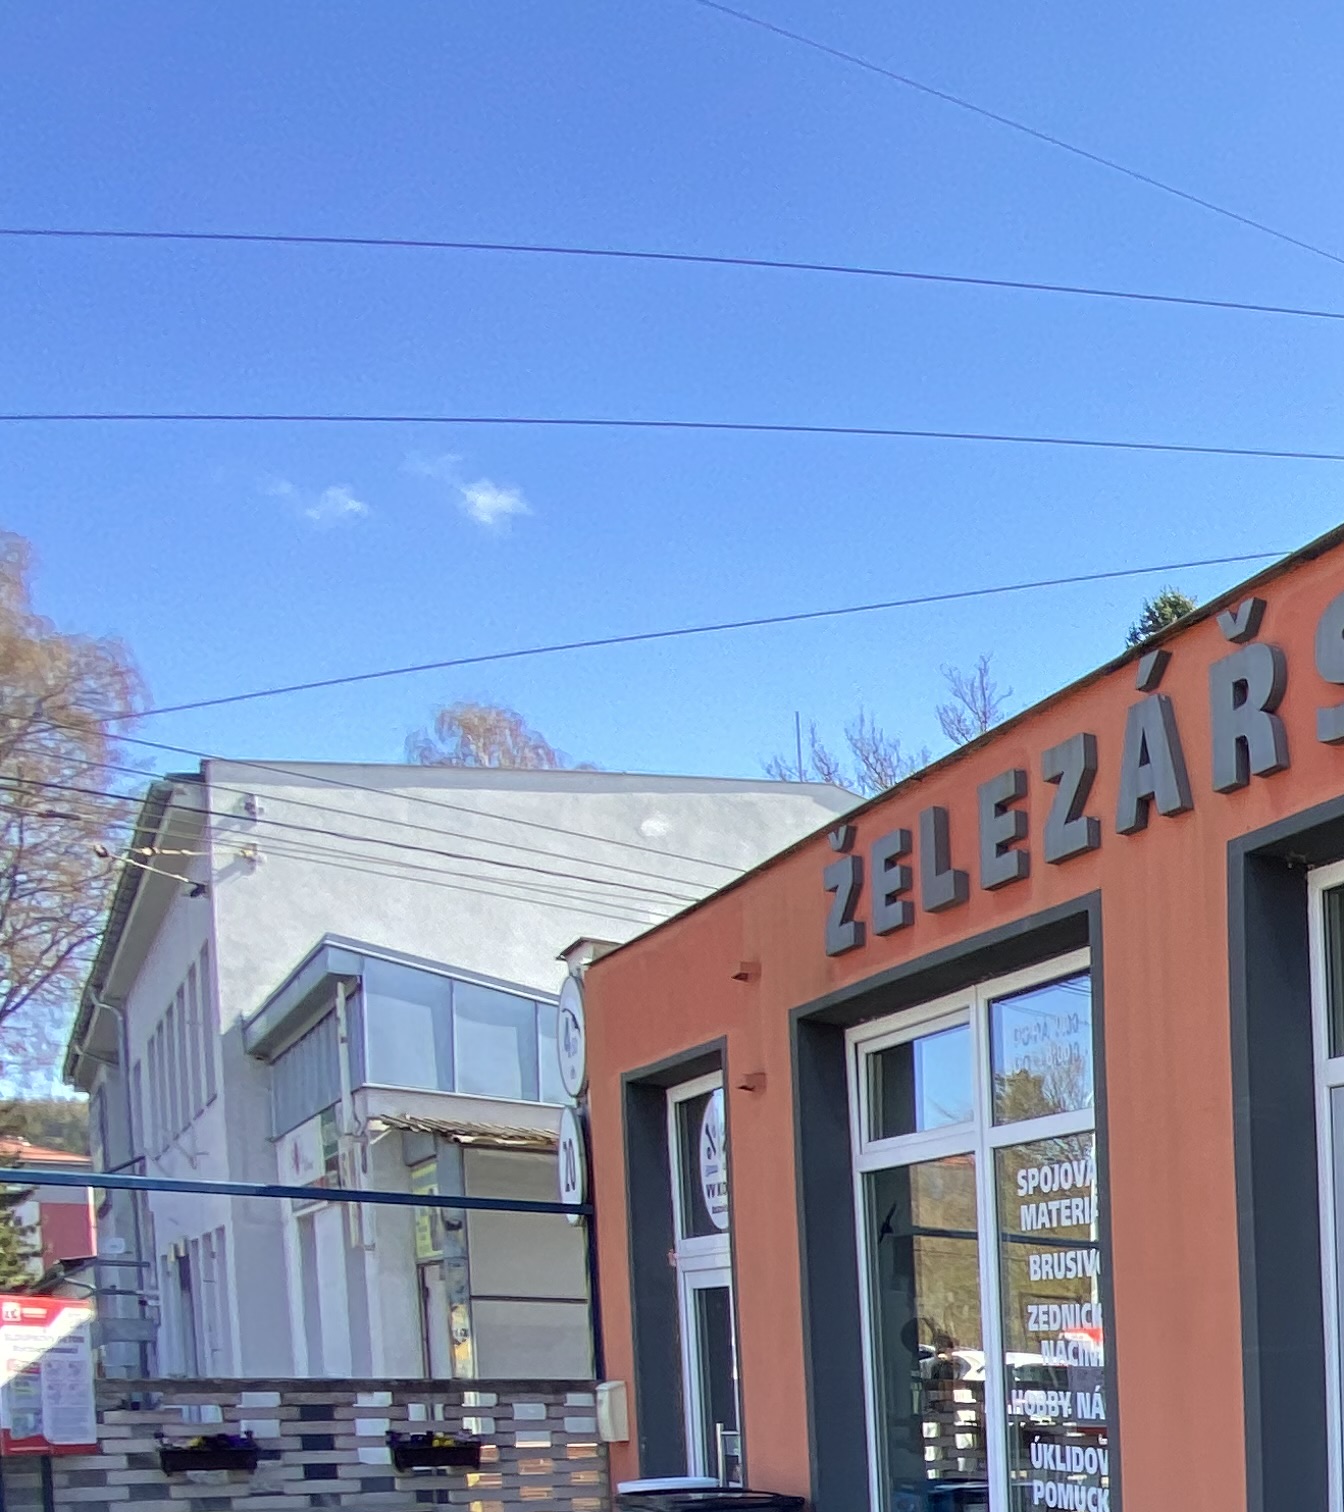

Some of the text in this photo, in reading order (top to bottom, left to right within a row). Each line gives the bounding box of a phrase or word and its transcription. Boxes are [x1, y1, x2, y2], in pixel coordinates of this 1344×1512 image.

[1017, 1158, 1097, 1196] SPOJOVA
[1027, 1302, 1103, 1332] ZEDNICK
[1030, 1435, 1109, 1476] ÚKLIDOV
